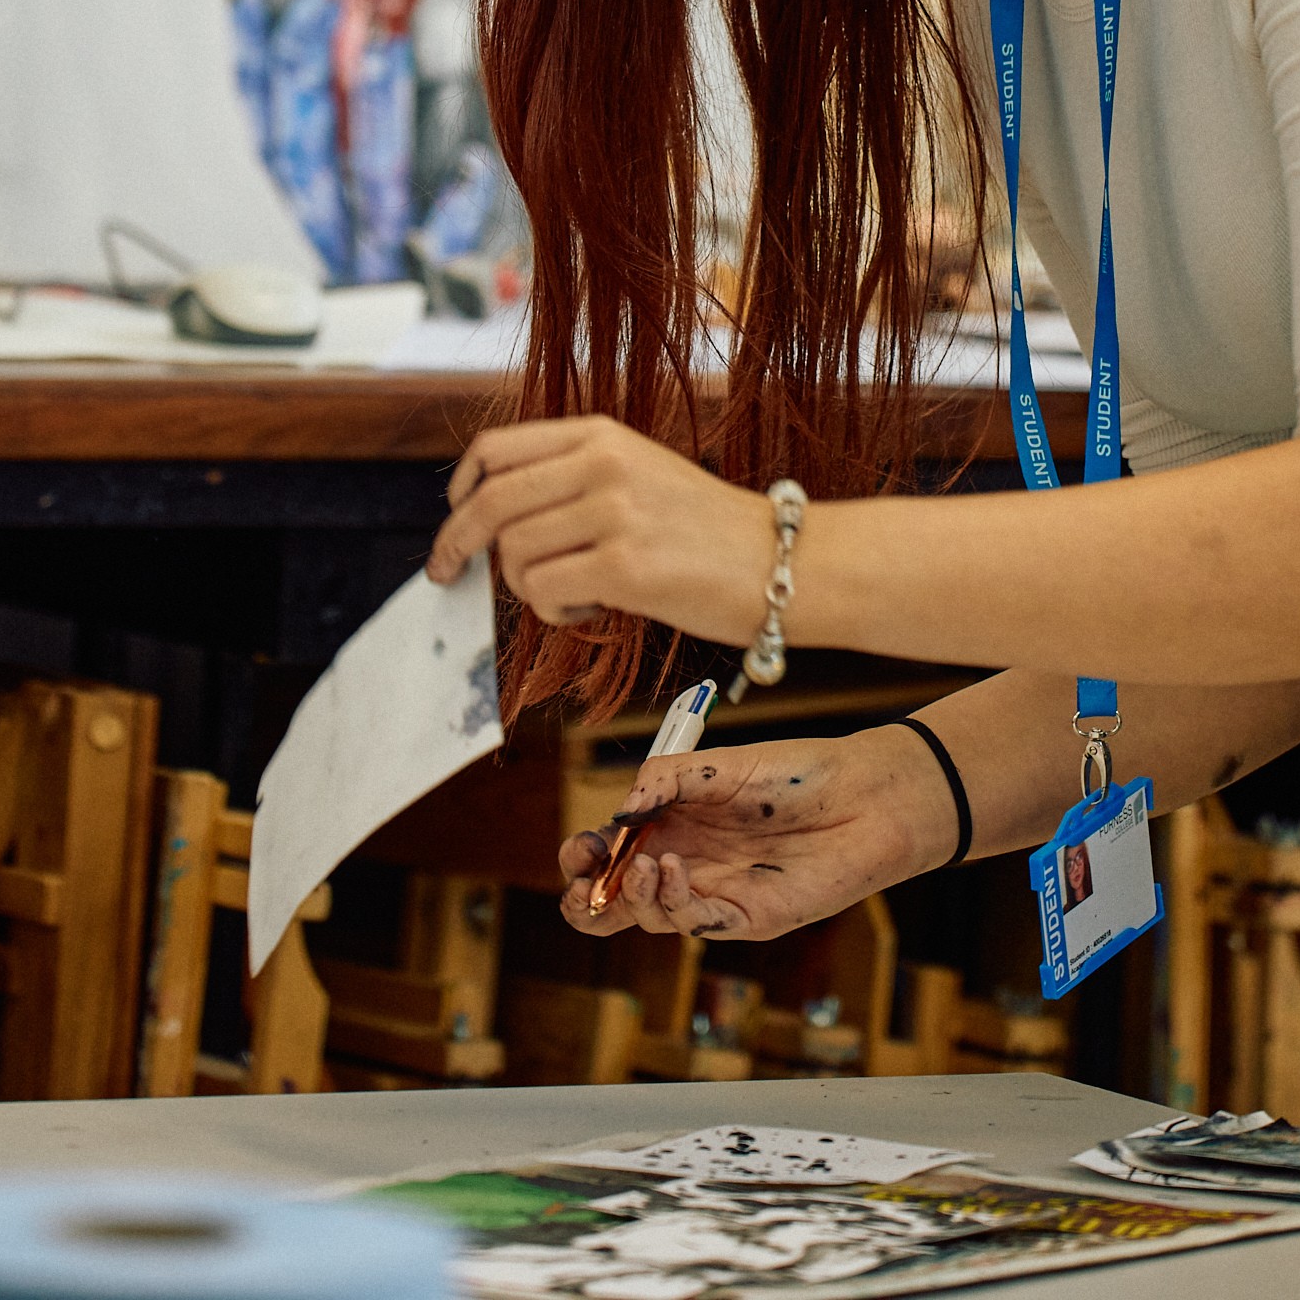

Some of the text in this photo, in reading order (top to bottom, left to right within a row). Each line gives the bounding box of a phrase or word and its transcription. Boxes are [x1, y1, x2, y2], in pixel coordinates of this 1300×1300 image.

[1001, 43, 1014, 141] STUDENT
[1102, 3, 1115, 103] STUDENT
[1019, 393, 1053, 489] STUDENT
[1096, 358, 1112, 457] STUDENT
[1099, 803, 1133, 838] FURNESS
[1043, 864, 1065, 982] STUDENT
